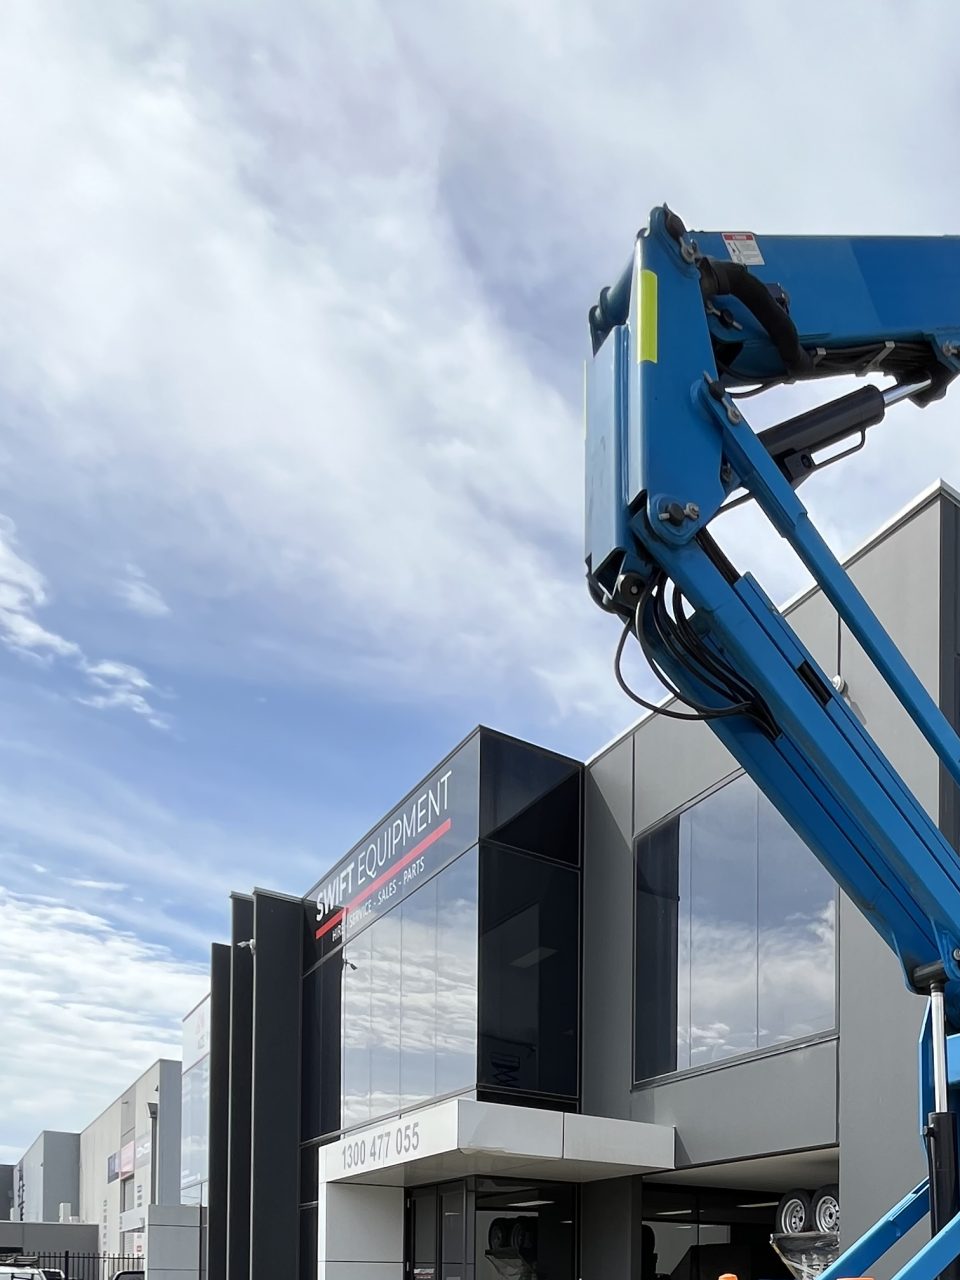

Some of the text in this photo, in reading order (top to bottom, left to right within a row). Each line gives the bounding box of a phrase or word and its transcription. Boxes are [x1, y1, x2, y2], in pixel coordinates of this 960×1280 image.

[316, 770, 452, 922] SWIFT EQUIPMENT
[350, 899, 372, 928] SERVICE
[377, 879, 397, 906] SALES
[403, 856, 425, 886] PARTS
[342, 1122, 419, 1170] 1300 477 055
